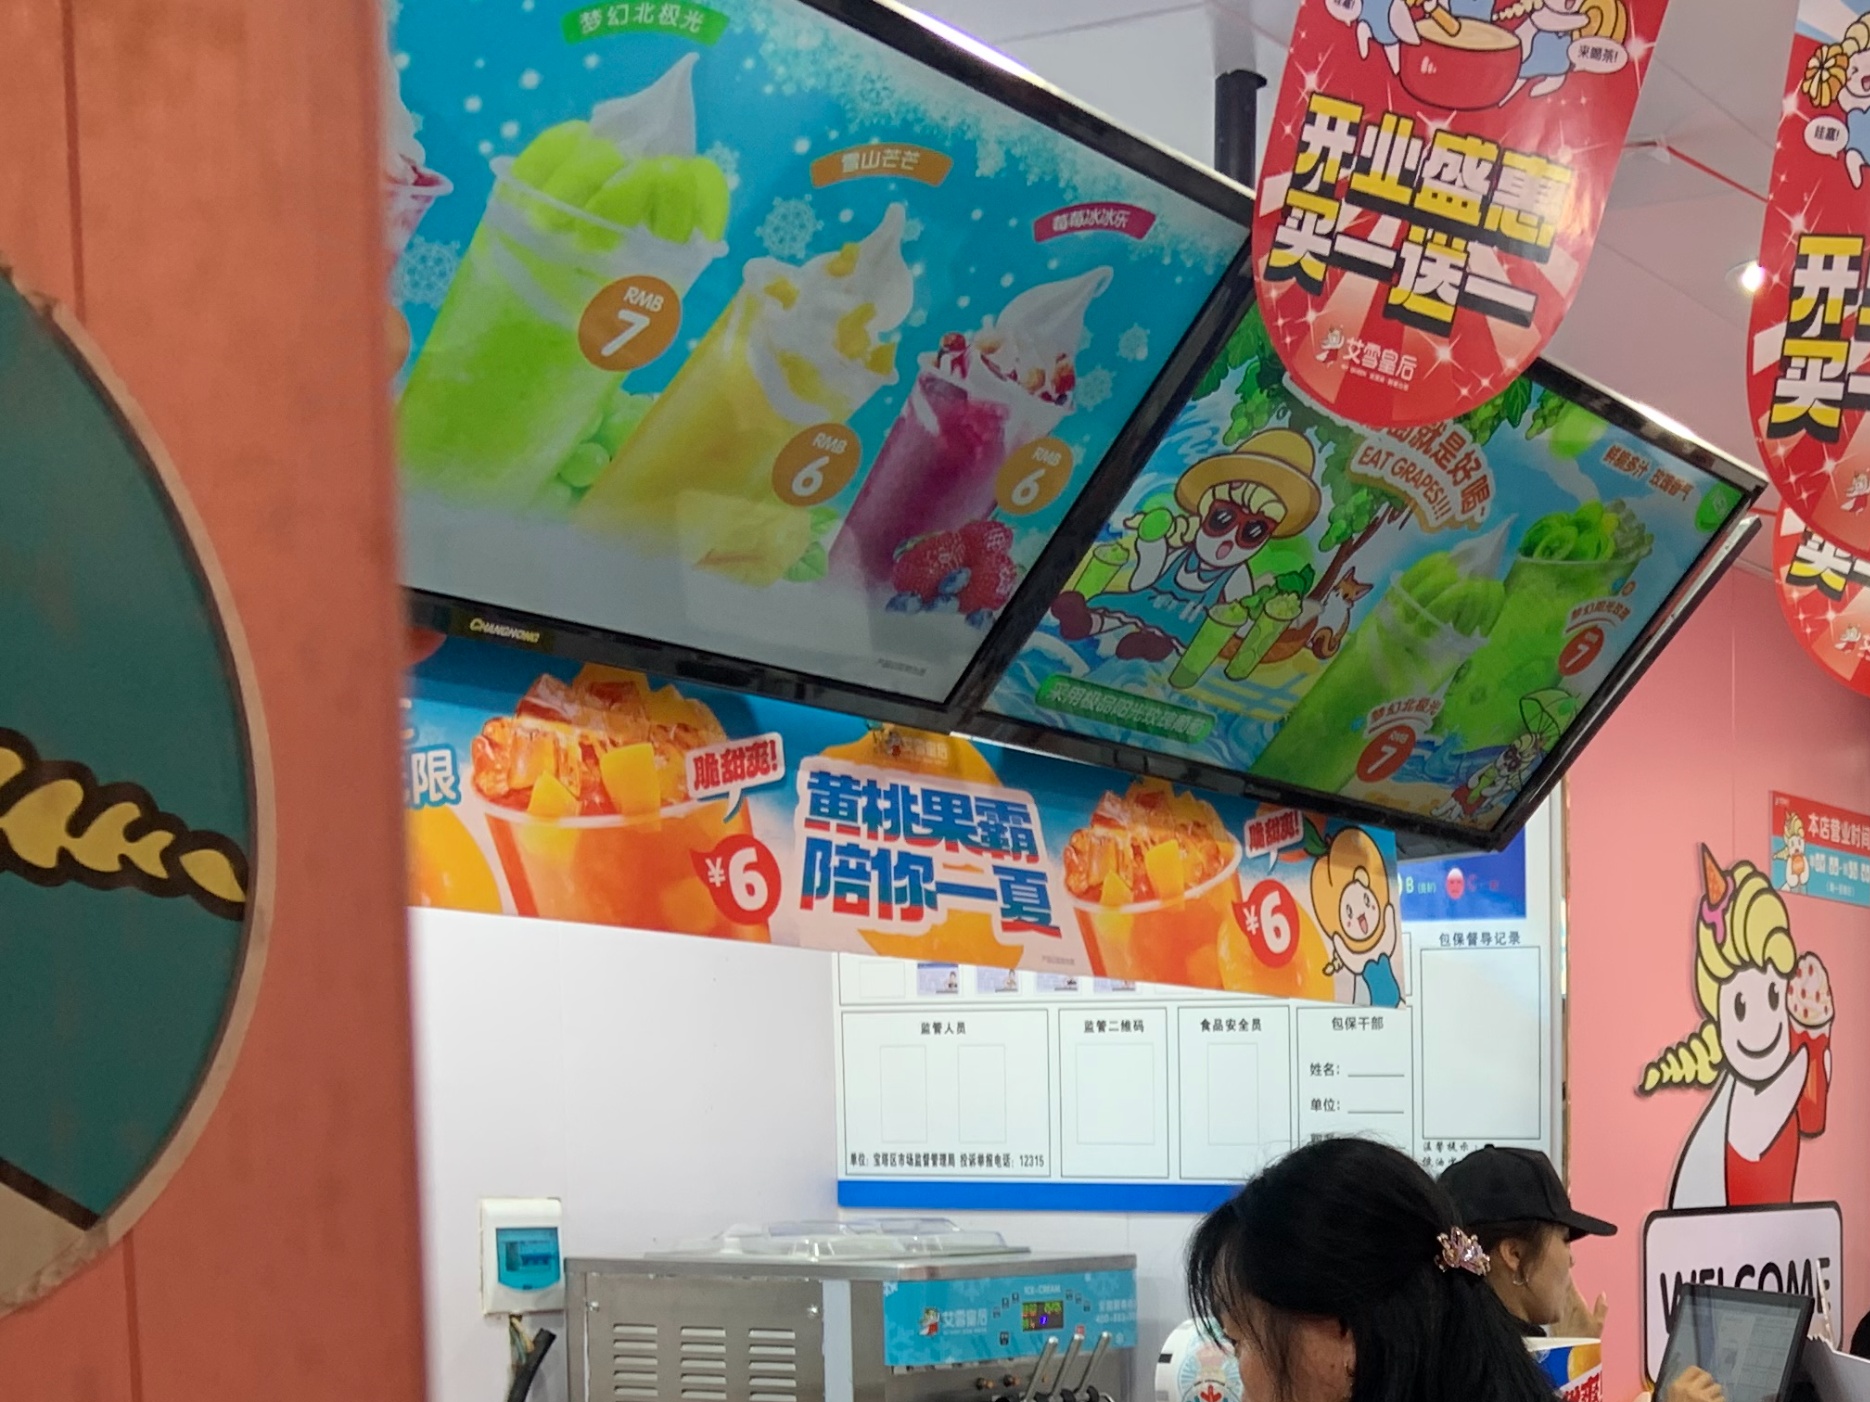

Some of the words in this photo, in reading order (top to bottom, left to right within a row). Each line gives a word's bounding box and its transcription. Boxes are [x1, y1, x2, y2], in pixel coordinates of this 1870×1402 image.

[579, 1, 705, 34] 梦幻北极光
[1577, 42, 1620, 66] 来喝茶!
[840, 149, 921, 175] 雪山芒芒
[1292, 92, 1575, 263] 开业盛惠
[1264, 188, 1539, 338] 买一送一
[623, 286, 665, 313] RMB
[600, 311, 651, 358] 7
[1342, 336, 1418, 381] 艾雪皇后
[811, 432, 849, 454] RMB
[1030, 446, 1063, 467] RMB
[791, 453, 827, 497] 6
[1011, 467, 1044, 507] 6
[1357, 446, 1389, 468] EAT
[1390, 456, 1452, 520] GRAPES!!!
[469, 617, 541, 644] CHANGHONG
[692, 739, 779, 790] 脆甜爽!
[1366, 748, 1398, 775] 7
[804, 769, 1041, 864] 黄桃果霸
[1248, 812, 1299, 853] 脆甜爽!
[801, 838, 1063, 939] 陪你一夏
[1438, 930, 1522, 947] 包保督导记录
[921, 1021, 966, 1035] 监管人员
[1083, 1018, 1145, 1034] 监管二维码
[1199, 1017, 1262, 1033] 食品安全员
[1331, 1015, 1384, 1032] 包保干部
[1309, 1061, 1342, 1078] 姓名：
[1310, 1096, 1342, 1113] 单位：
[1660, 1257, 1831, 1335] WOME
